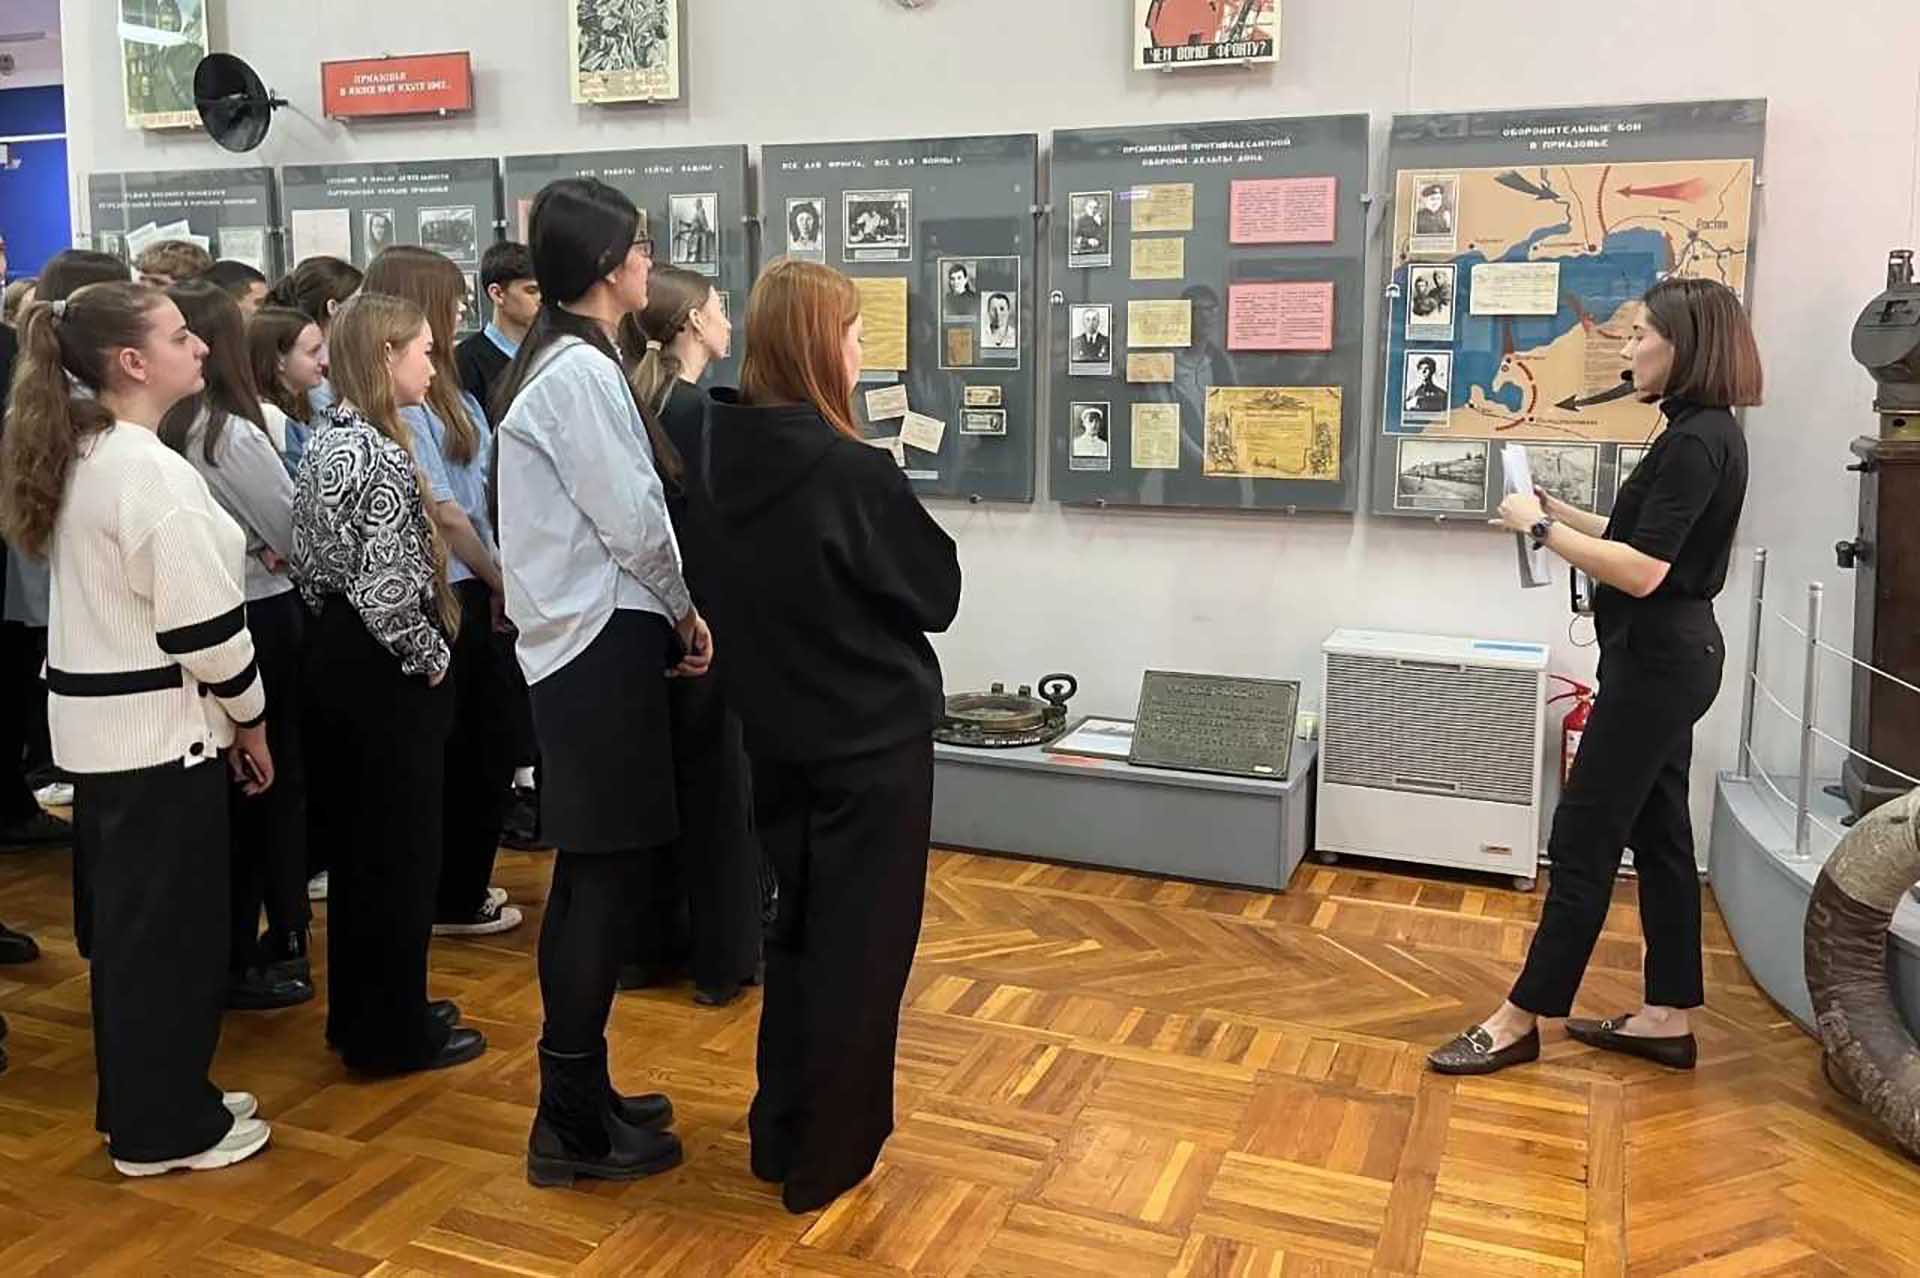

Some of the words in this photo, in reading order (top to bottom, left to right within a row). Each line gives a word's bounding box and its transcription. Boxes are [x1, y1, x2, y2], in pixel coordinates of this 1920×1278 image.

[1150, 47, 1171, 62] ЧЕМ
[1215, 41, 1266, 58] ФРОНТУ?
[1503, 123, 1611, 136] ОБОРОНИТЕЛЬНЫЕ
[1617, 123, 1642, 131] БОИ
[1529, 141, 1537, 150] В
[1542, 139, 1609, 150] ПРИАЗОВЬЕ
